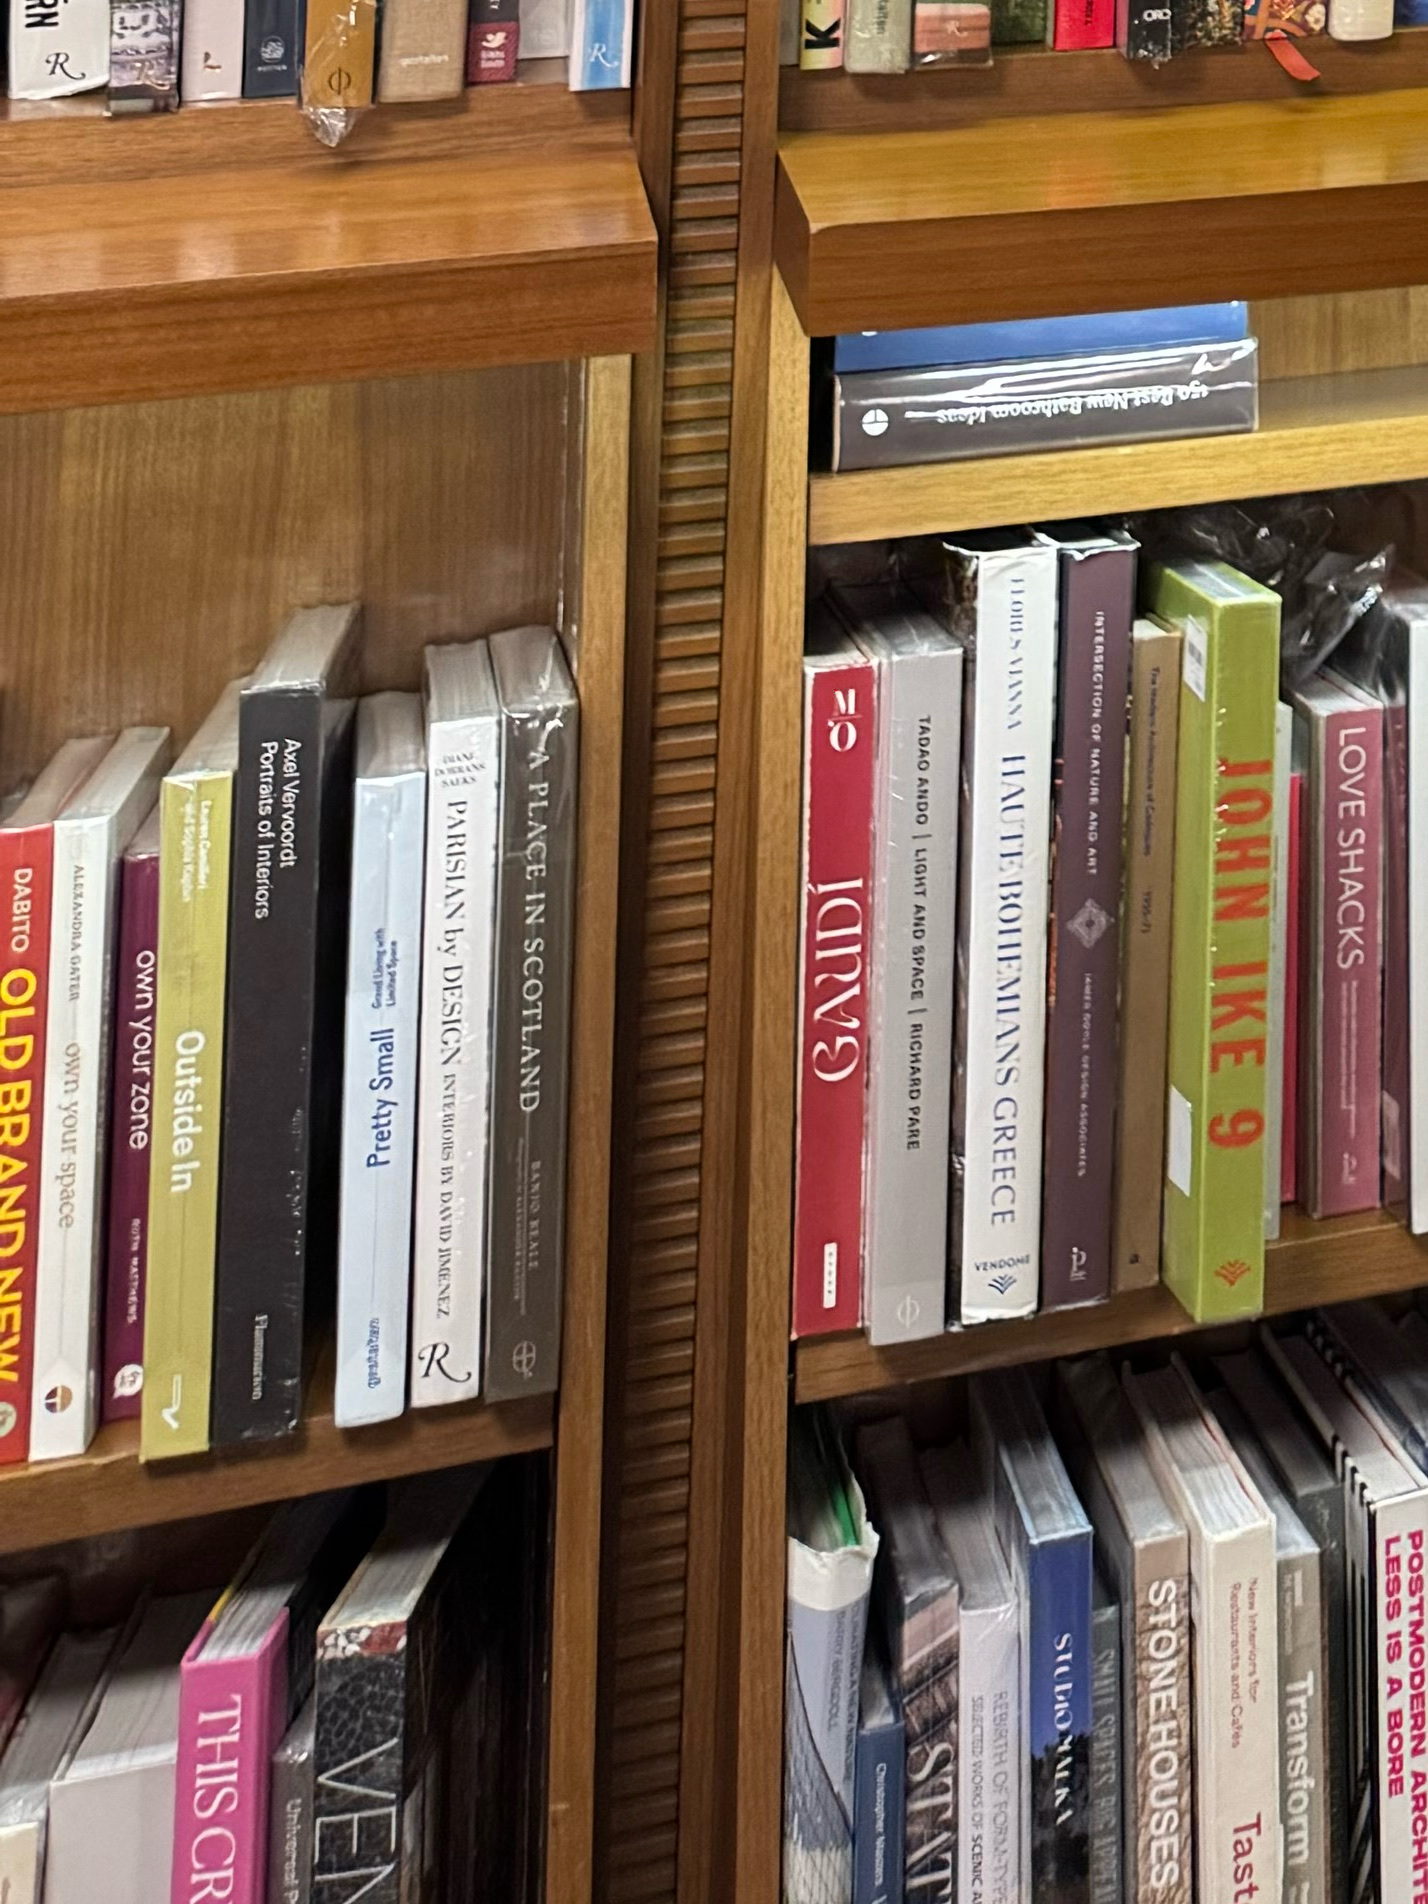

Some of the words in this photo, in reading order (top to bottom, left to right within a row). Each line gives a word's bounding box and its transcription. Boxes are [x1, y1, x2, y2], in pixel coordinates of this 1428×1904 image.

[260, 740, 280, 814] Portraits
[282, 738, 304, 777] Axel
[1337, 727, 1368, 821] LOVE
[258, 818, 274, 838] of
[280, 777, 301, 868] Vervoordt
[1211, 758, 1272, 933] JOHN
[10, 867, 35, 954] DABITO
[253, 843, 274, 920] Interiors
[1334, 825, 1366, 970] SHACKS
[136, 949, 157, 1007] own
[811, 875, 866, 1085] GAUDÍ
[130, 1011, 154, 1077] your
[1207, 958, 1268, 1076] IKE
[66, 1042, 82, 1099] own
[172, 1030, 207, 1155] Outside
[368, 1027, 396, 1093] Small
[60, 1101, 80, 1160] your
[128, 1078, 152, 1150] zone
[367, 1096, 399, 1168] Pretty
[1205, 1107, 1266, 1151] 9
[56, 1166, 80, 1231] space
[171, 1162, 199, 1195] In
[1384, 1536, 1402, 1621] LESS
[1385, 1631, 1403, 1665] IS
[1405, 1529, 1426, 1759] POSTMODERN
[1386, 1675, 1403, 1699] A
[1145, 1578, 1178, 1890] STONEHOUSES
[1387, 1714, 1404, 1799] BORE
